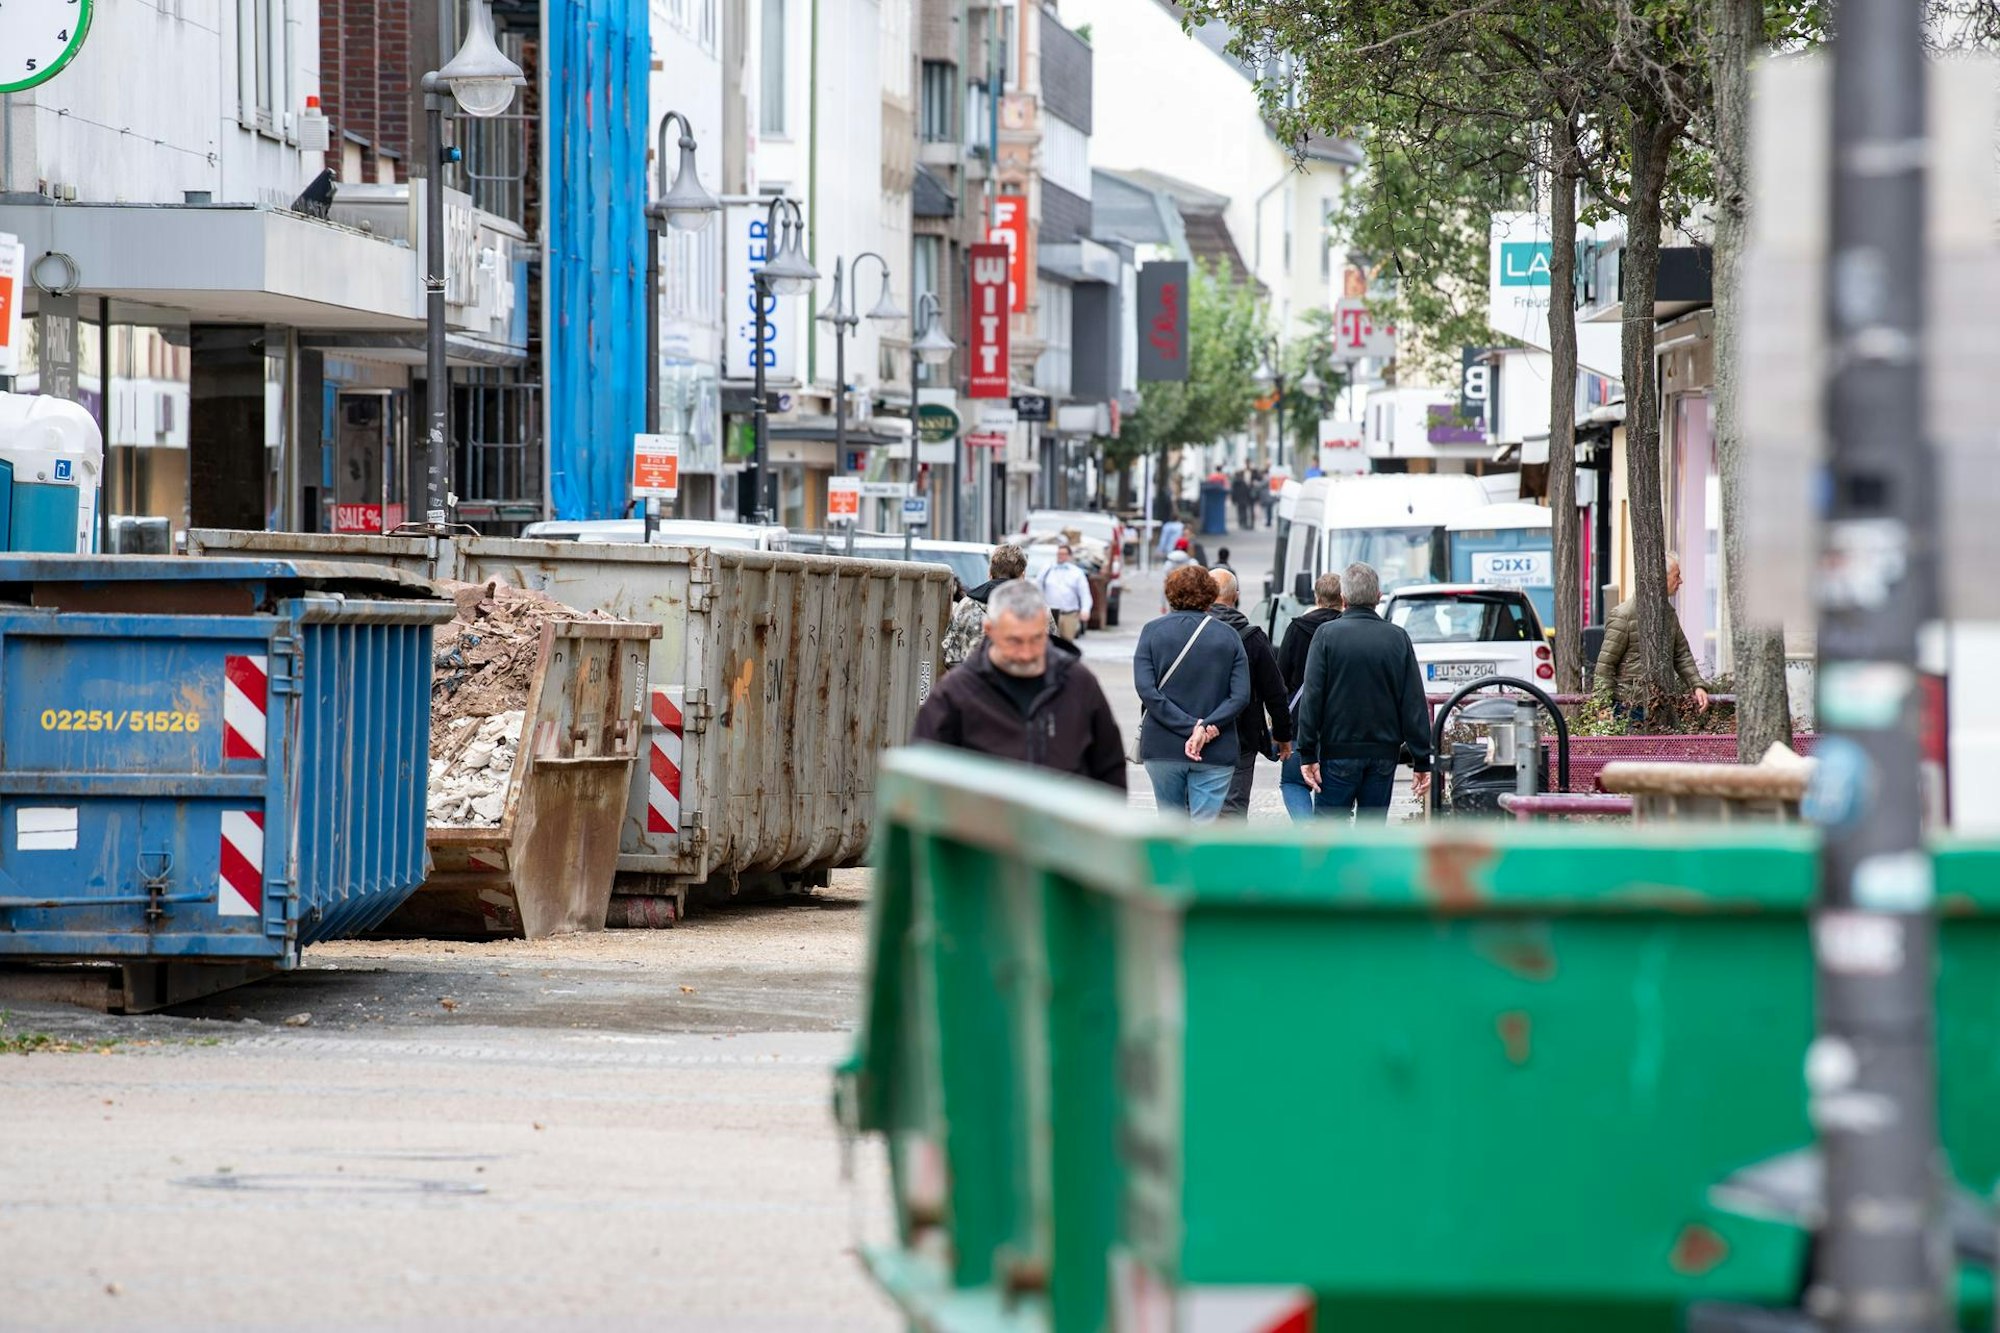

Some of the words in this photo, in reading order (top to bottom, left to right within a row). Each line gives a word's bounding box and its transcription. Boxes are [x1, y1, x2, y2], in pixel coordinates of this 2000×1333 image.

[57, 29, 68, 41] 4
[26, 58, 36, 71] 5
[740, 219, 777, 368] BÜCER
[974, 257, 1006, 373] WITT
[338, 507, 365, 529] SALE
[1435, 665, 1449, 677] EU
[1457, 665, 1471, 676] SW
[1474, 664, 1494, 676] 204
[41, 709, 200, 732] 02251/51526
